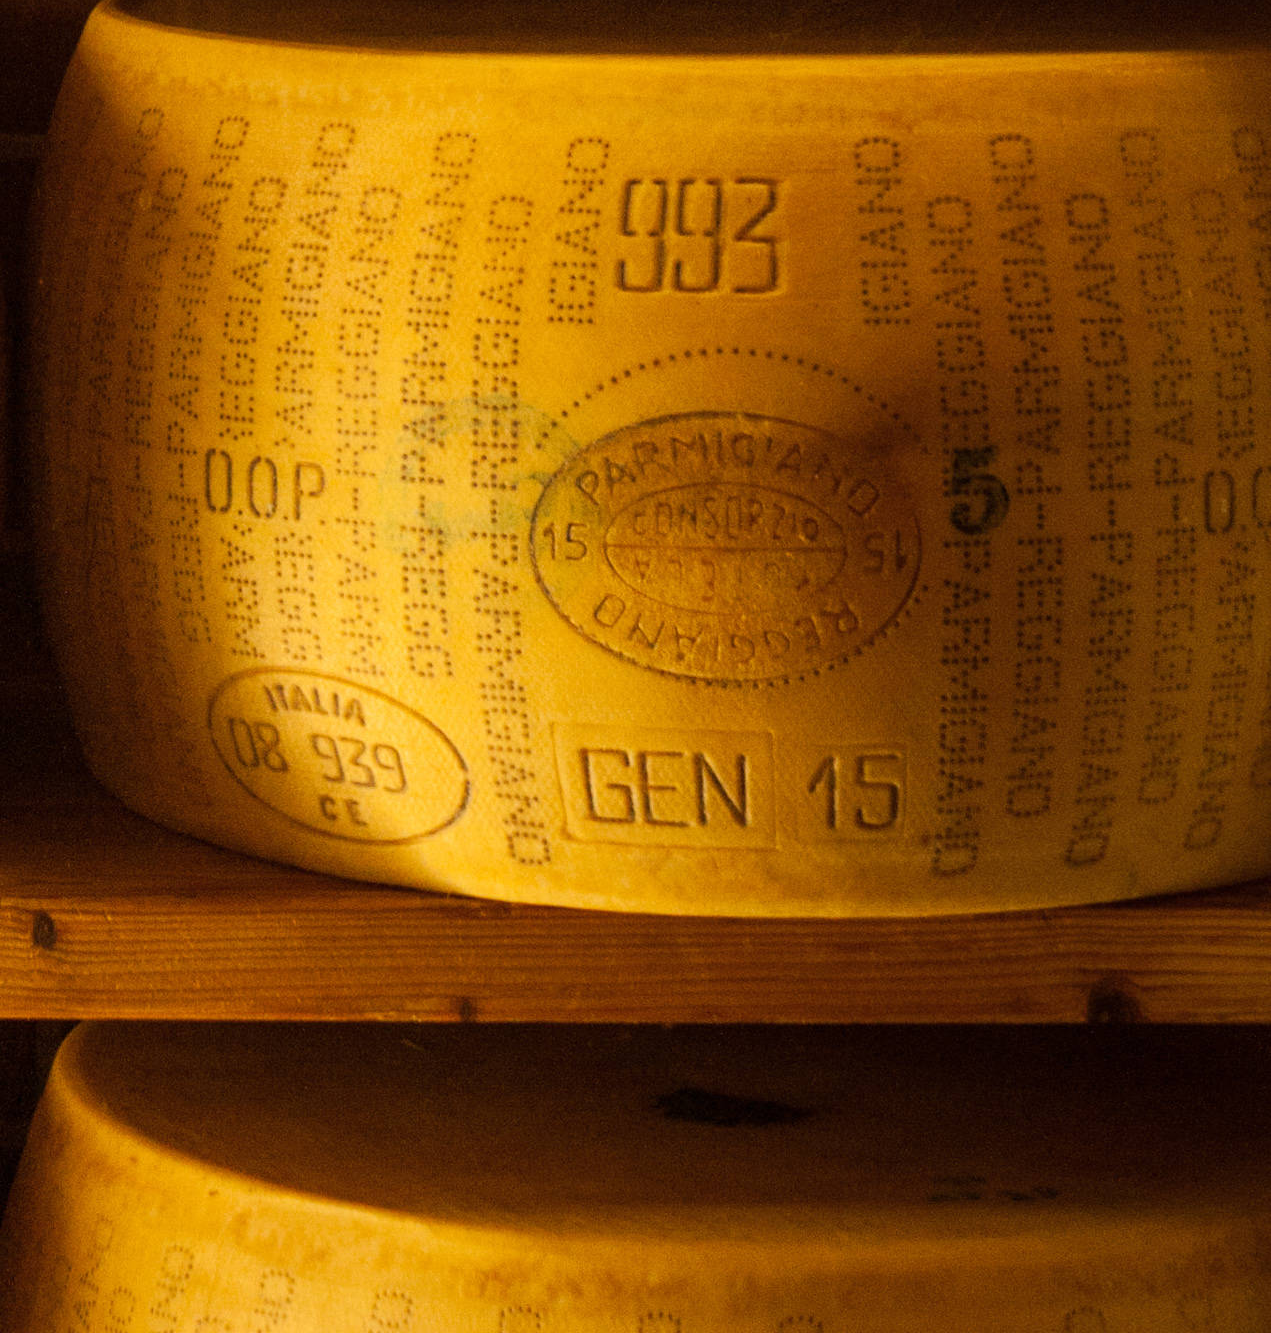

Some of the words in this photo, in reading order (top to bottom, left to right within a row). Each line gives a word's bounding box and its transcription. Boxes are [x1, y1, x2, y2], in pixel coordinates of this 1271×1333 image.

[615, 176, 781, 295] 993
[949, 446, 1012, 534] 5
[543, 523, 588, 561] 15
[263, 683, 367, 728] ITALIA
[227, 716, 290, 774] 08
[311, 733, 408, 795] 939
[580, 746, 750, 830] GEN
[807, 751, 903, 832] 15
